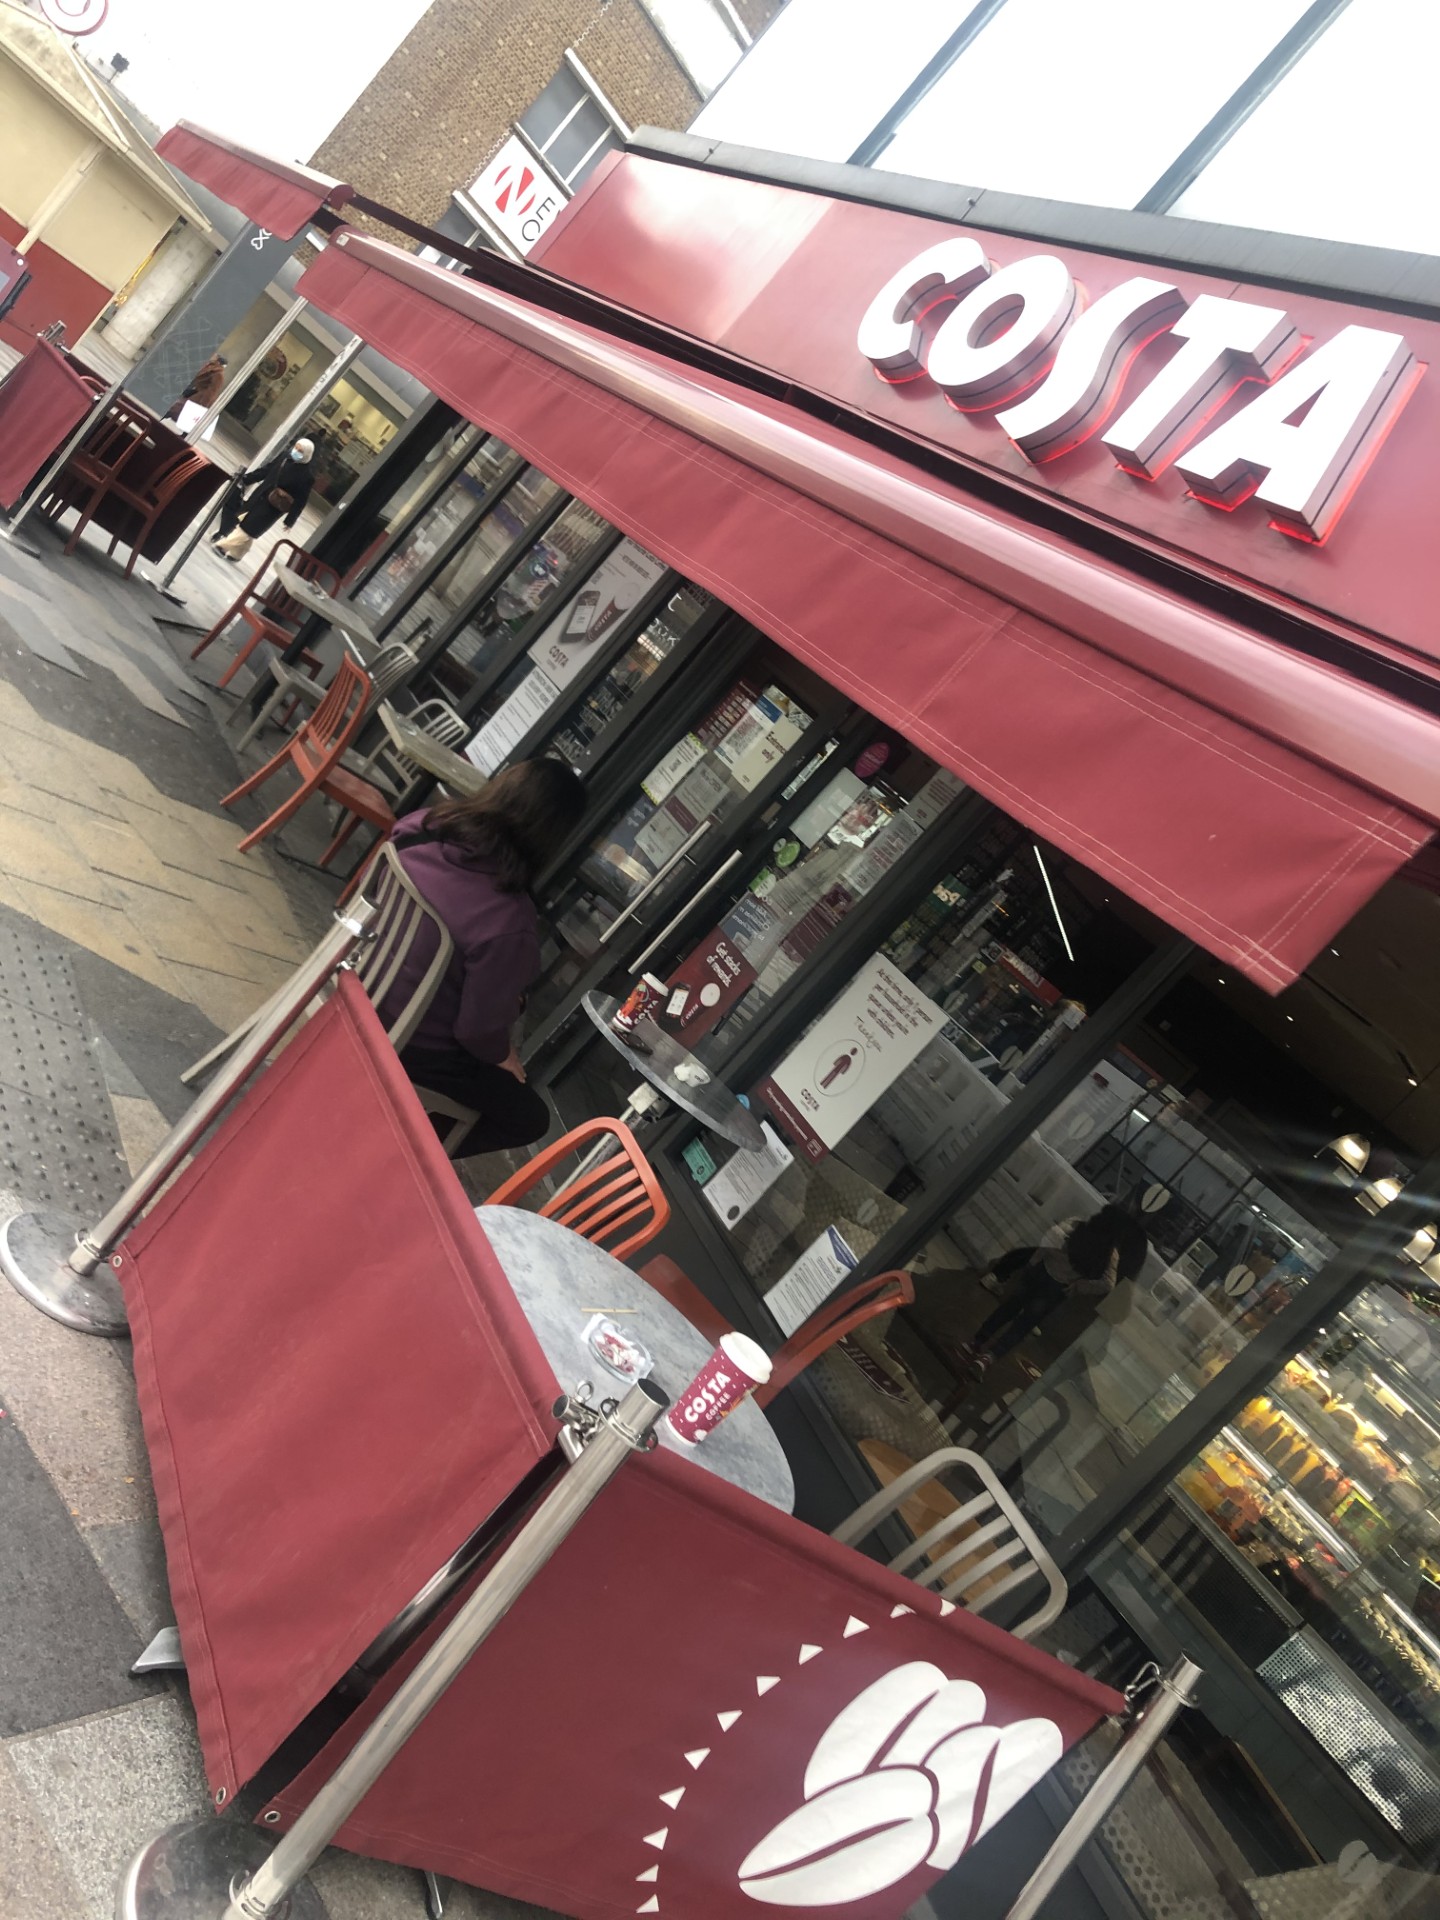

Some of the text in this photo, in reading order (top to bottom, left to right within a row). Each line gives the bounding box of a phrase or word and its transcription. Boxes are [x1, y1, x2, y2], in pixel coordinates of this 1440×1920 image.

[857, 237, 1416, 542] COSTA
[547, 644, 569, 668] COSTA
[760, 747, 777, 764] only
[704, 953, 716, 966] of
[714, 940, 742, 976] Get stacks
[865, 993, 882, 1008] queue
[880, 1006, 897, 1022] unless
[873, 983, 882, 992] per
[881, 988, 907, 1014] household
[908, 1016, 919, 1028] the
[876, 967, 885, 977] At
[882, 972, 894, 985] this
[902, 993, 915, 1006] only
[913, 1007, 933, 1024] person
[633, 998, 659, 1026] COSTA
[866, 1006, 877, 1019] with
[799, 1087, 820, 1111] COSTA
[684, 1371, 731, 1423] COSTA
[705, 1392, 731, 1421] COFFEE
